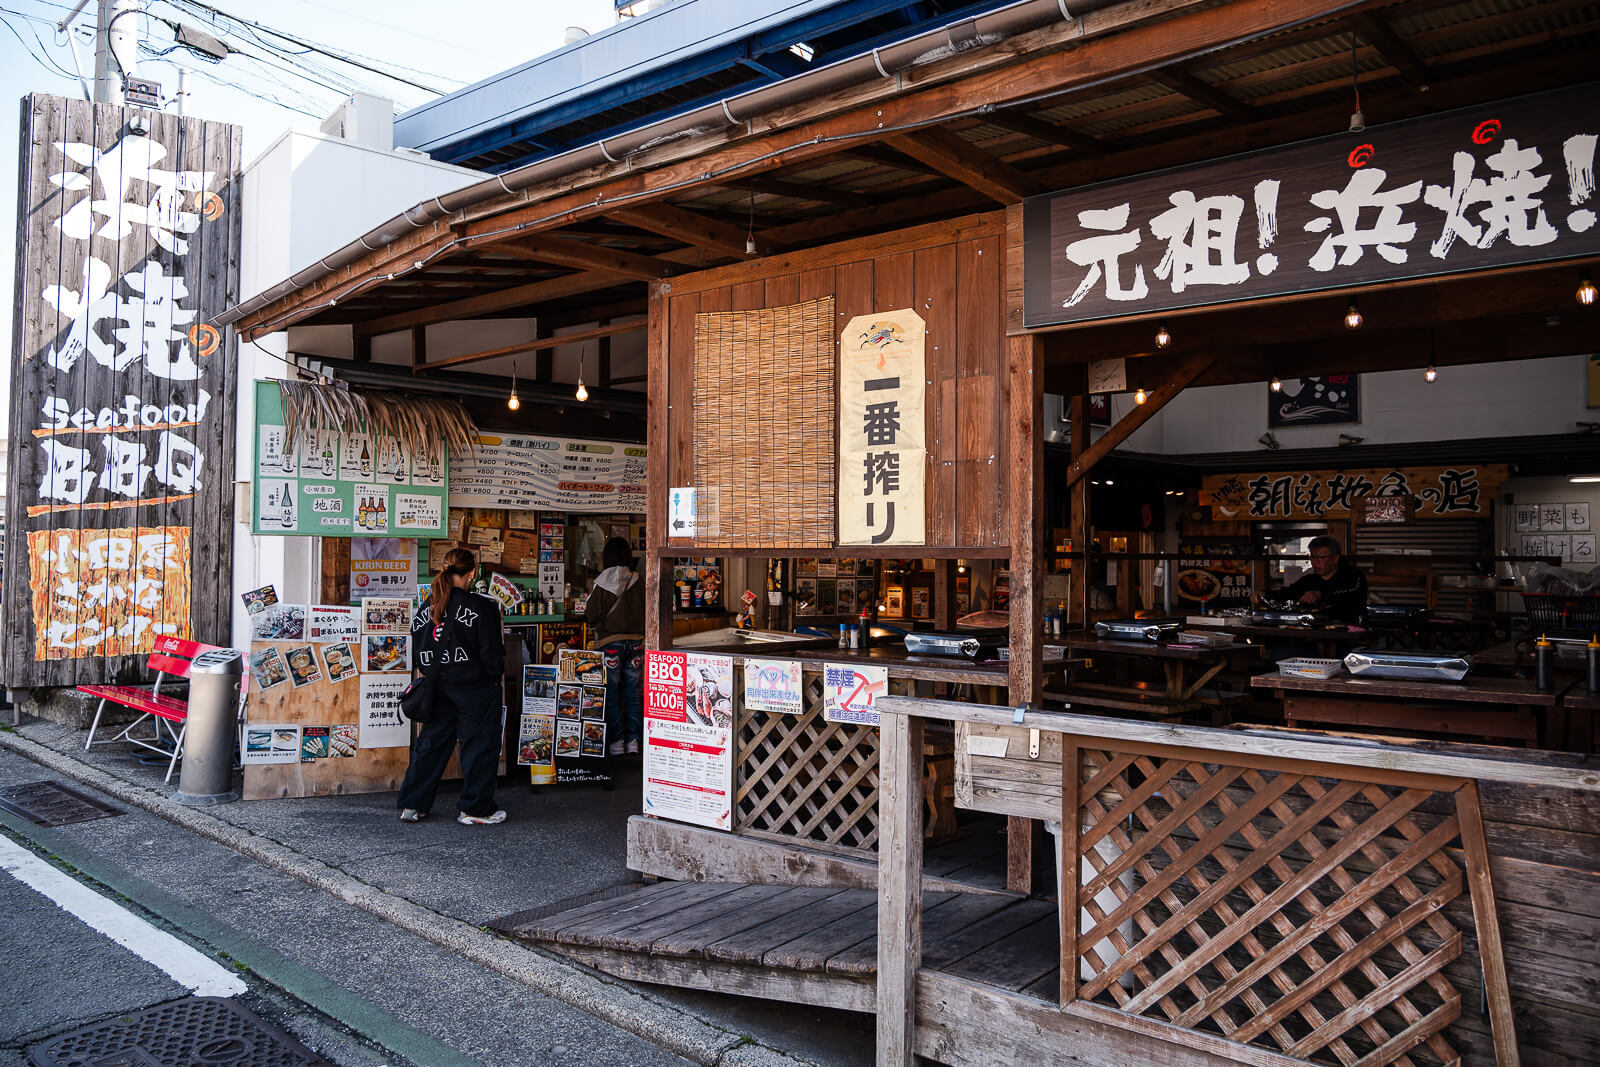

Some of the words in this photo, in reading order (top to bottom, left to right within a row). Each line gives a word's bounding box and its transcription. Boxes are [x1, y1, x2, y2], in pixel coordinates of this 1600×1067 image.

[40, 388, 211, 430] Seafood
[39, 430, 204, 504] BBQ
[863, 376, 901, 544] 一番搾り
[314, 499, 341, 511] 地酒
[1518, 508, 1586, 526] 野菜も
[40, 534, 182, 574] 小田原
[354, 561, 383, 570] KIRIN
[384, 561, 407, 570] BEER
[371, 575, 408, 585] 一番搾り
[44, 615, 178, 650] センター
[648, 653, 684, 665] SEAFOOD
[648, 661, 684, 682] BBQ
[759, 670, 790, 683] ペット
[826, 668, 855, 687] 禁煙
[746, 687, 801, 701] 同伴出来ません
[370, 701, 385, 709] BBQ
[369, 711, 394, 719] あります
